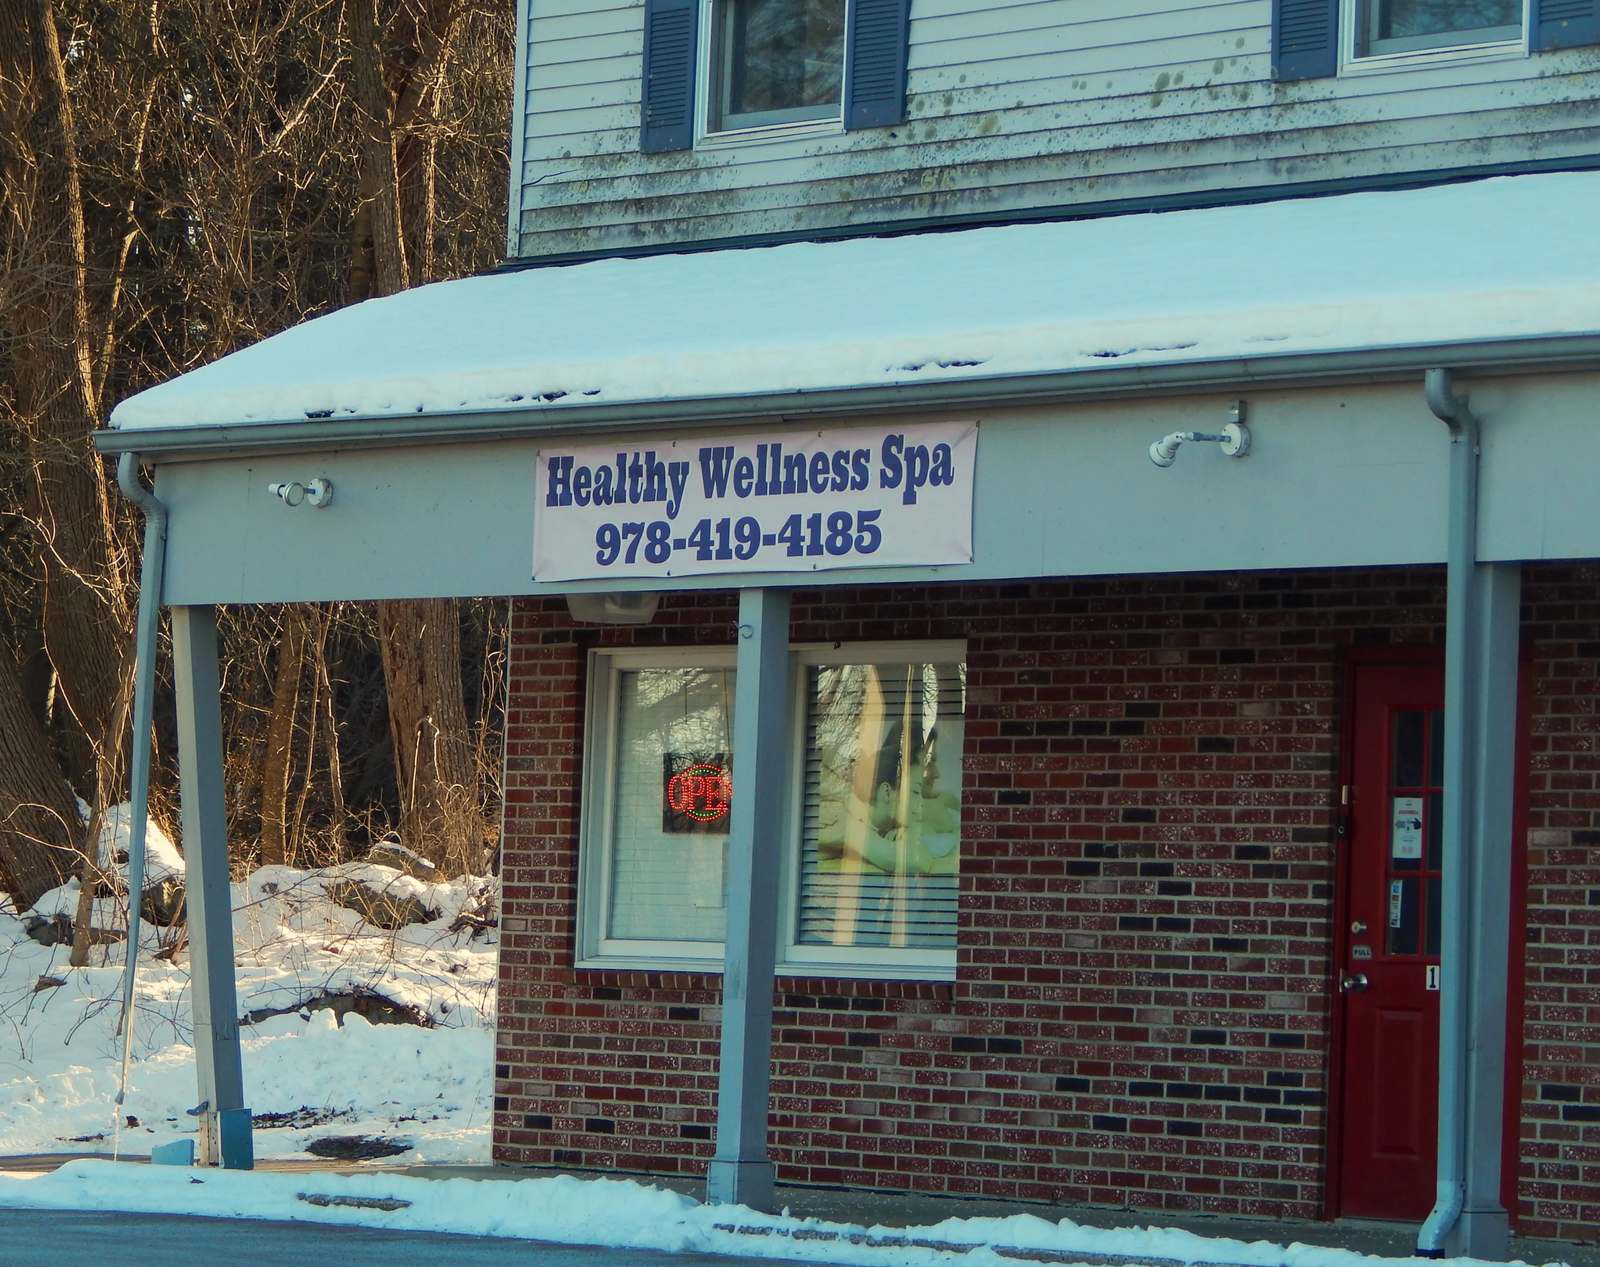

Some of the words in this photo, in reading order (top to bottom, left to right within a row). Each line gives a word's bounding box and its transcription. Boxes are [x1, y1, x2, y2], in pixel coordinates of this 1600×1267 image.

[545, 451, 690, 520] Healthy
[698, 442, 871, 499] Wellness
[879, 434, 956, 506] Spa
[595, 509, 883, 567] 978-419-4185
[1429, 966, 1437, 989] 1
